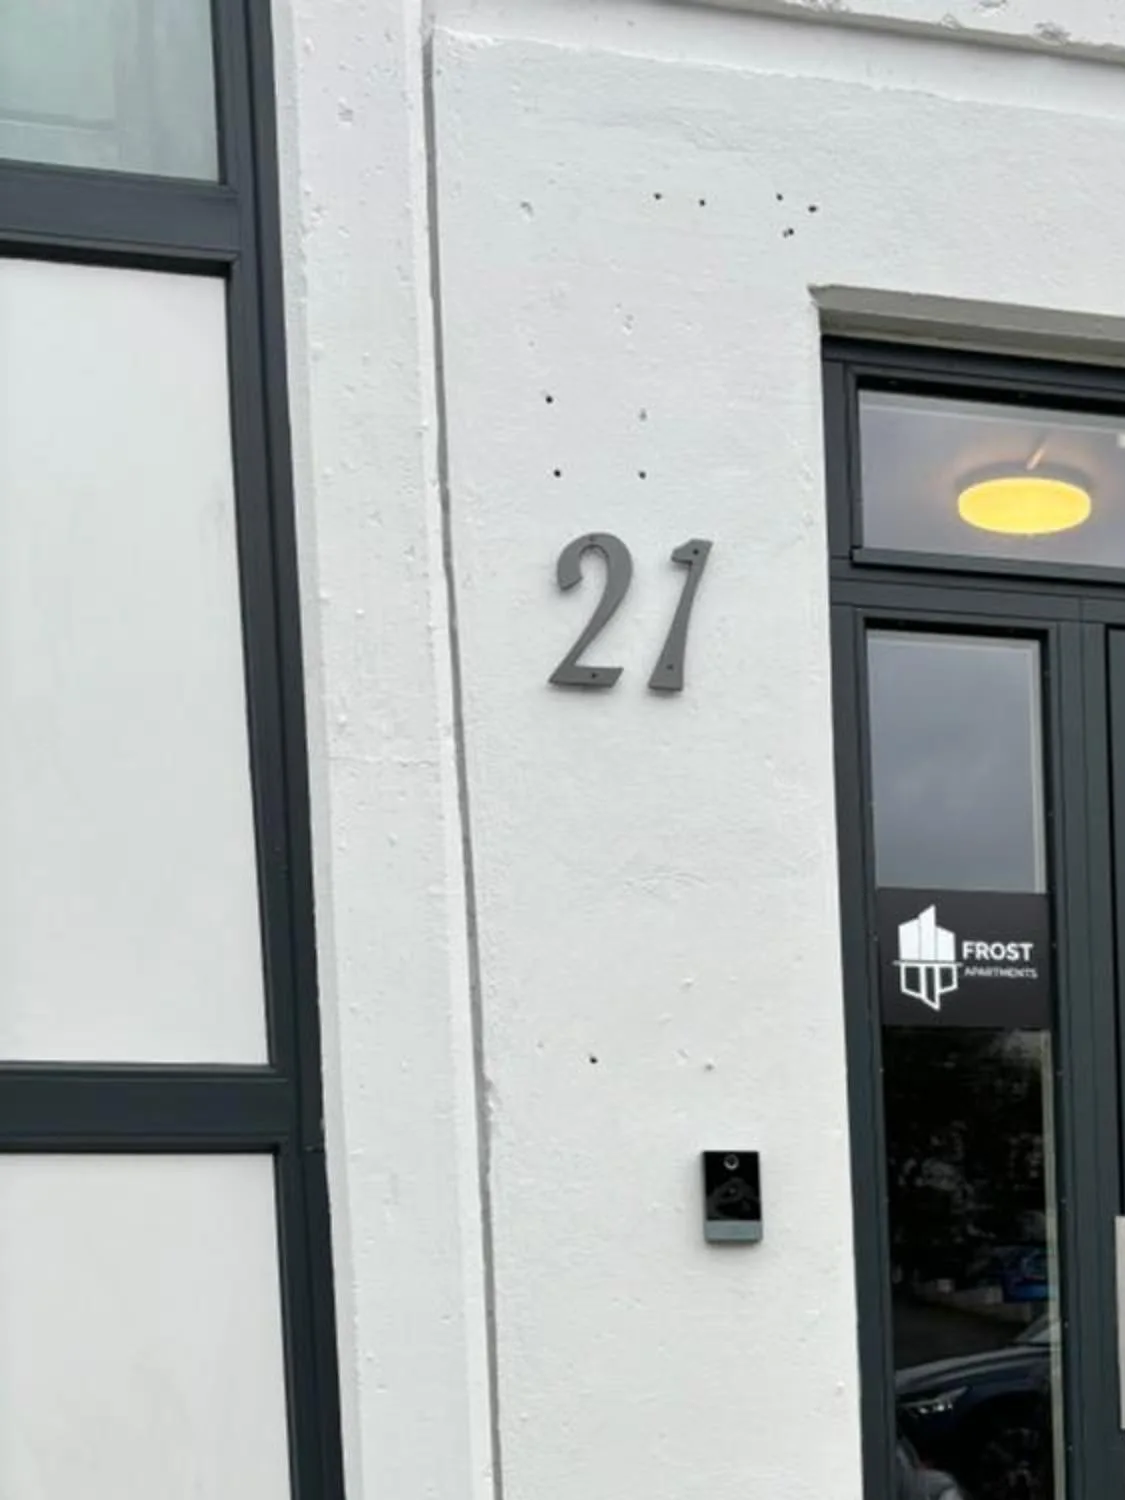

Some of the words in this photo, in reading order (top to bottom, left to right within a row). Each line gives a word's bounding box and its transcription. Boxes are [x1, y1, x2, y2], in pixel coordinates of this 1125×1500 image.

[548, 532, 713, 692] 21
[962, 940, 1034, 962] FROST
[963, 966, 1039, 979] APARTMENTS
